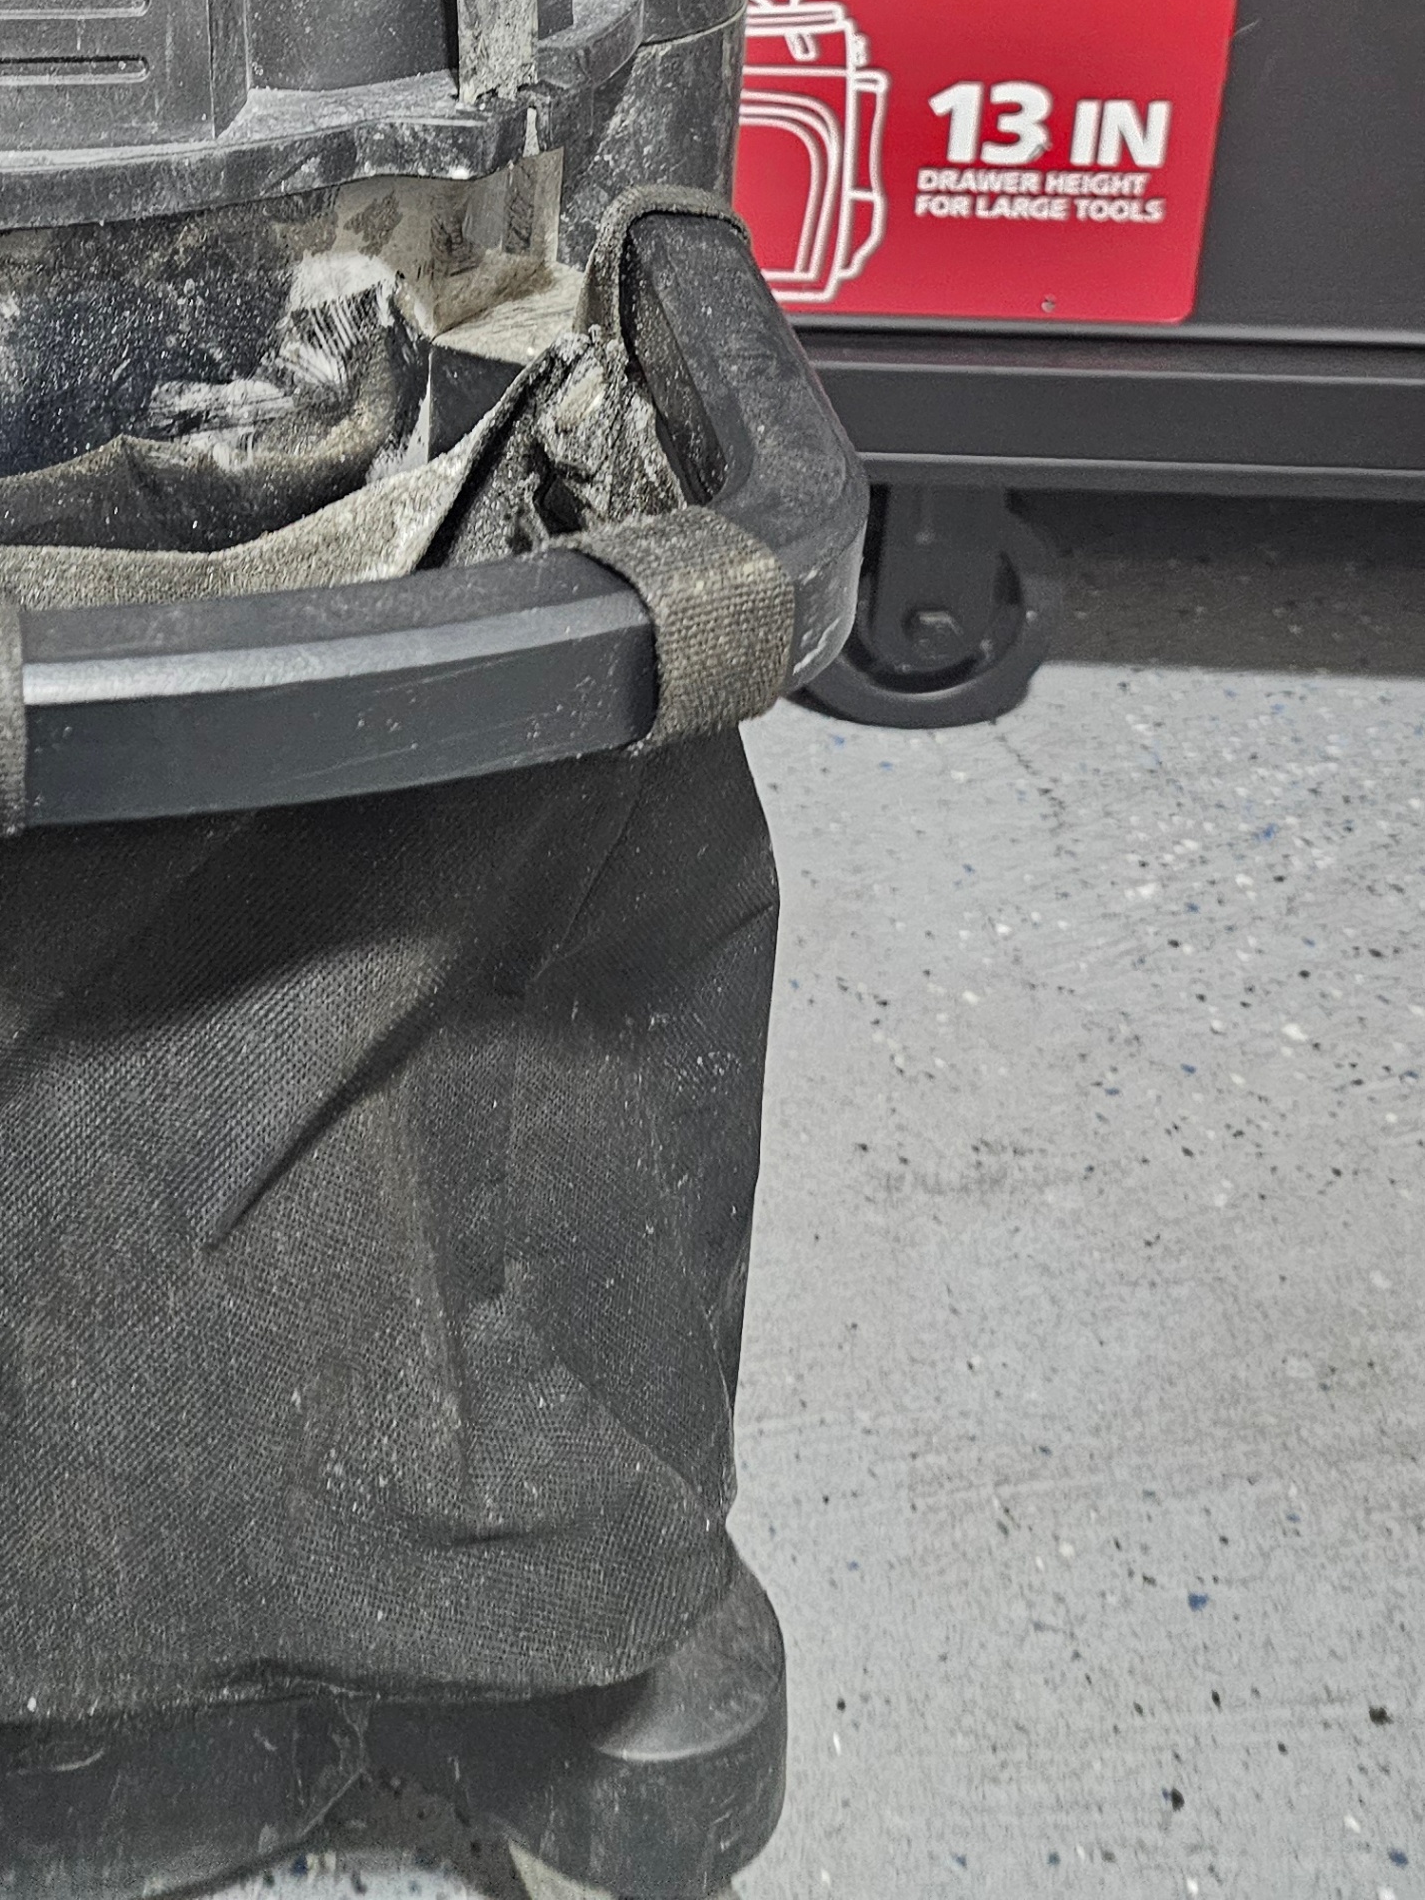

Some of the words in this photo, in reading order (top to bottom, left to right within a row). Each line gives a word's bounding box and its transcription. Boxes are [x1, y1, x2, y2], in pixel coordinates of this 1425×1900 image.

[928, 81, 1052, 166] 13
[1070, 100, 1172, 168] IN
[917, 169, 1041, 194] DRAWER
[1044, 171, 1150, 196] HEIGHT
[915, 194, 971, 218] FOR
[975, 195, 1070, 221] LARGE
[1074, 198, 1165, 223] TOOLS
